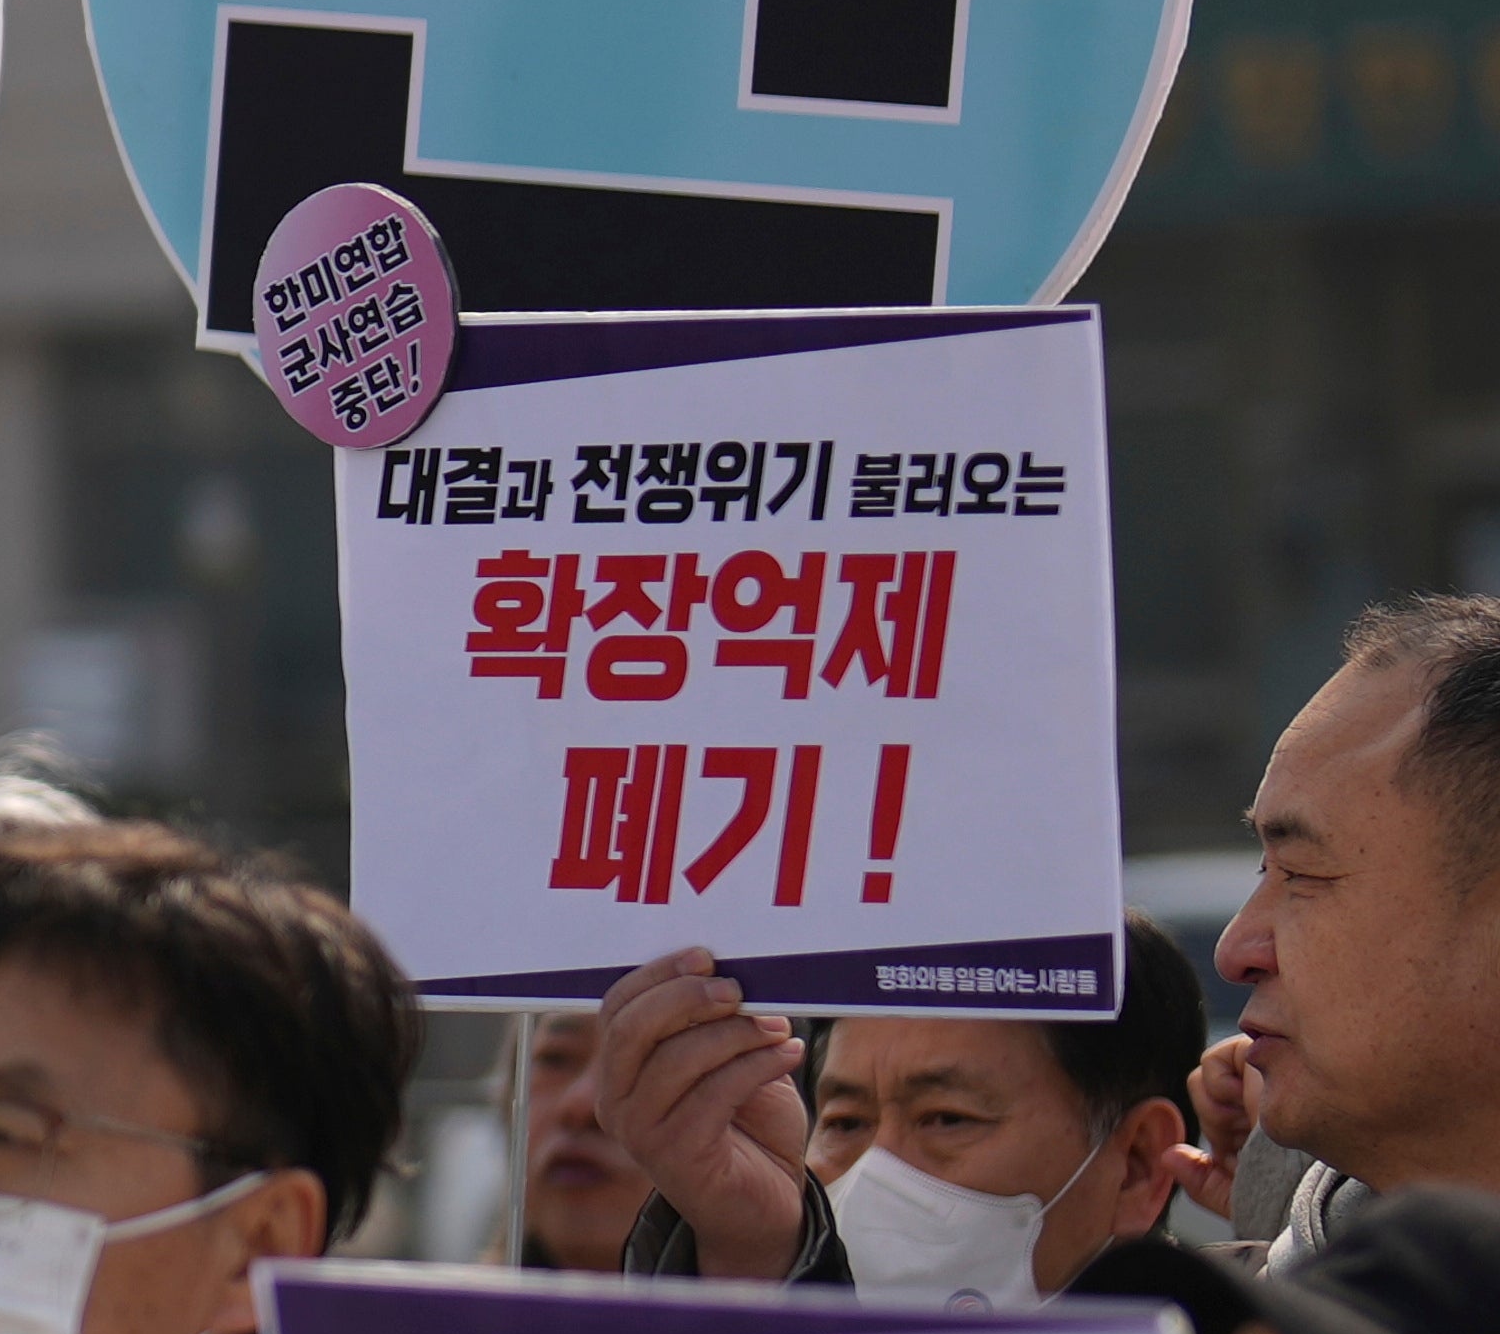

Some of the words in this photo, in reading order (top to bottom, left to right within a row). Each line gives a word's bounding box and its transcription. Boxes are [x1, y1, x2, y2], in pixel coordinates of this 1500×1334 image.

[262, 214, 412, 335] 한미연합
[278, 280, 426, 396] 군사연습
[378, 448, 552, 524] 대결과
[571, 441, 835, 524] 전쟁위기
[848, 451, 1067, 518] 불러오는
[465, 549, 956, 700] 확장억제
